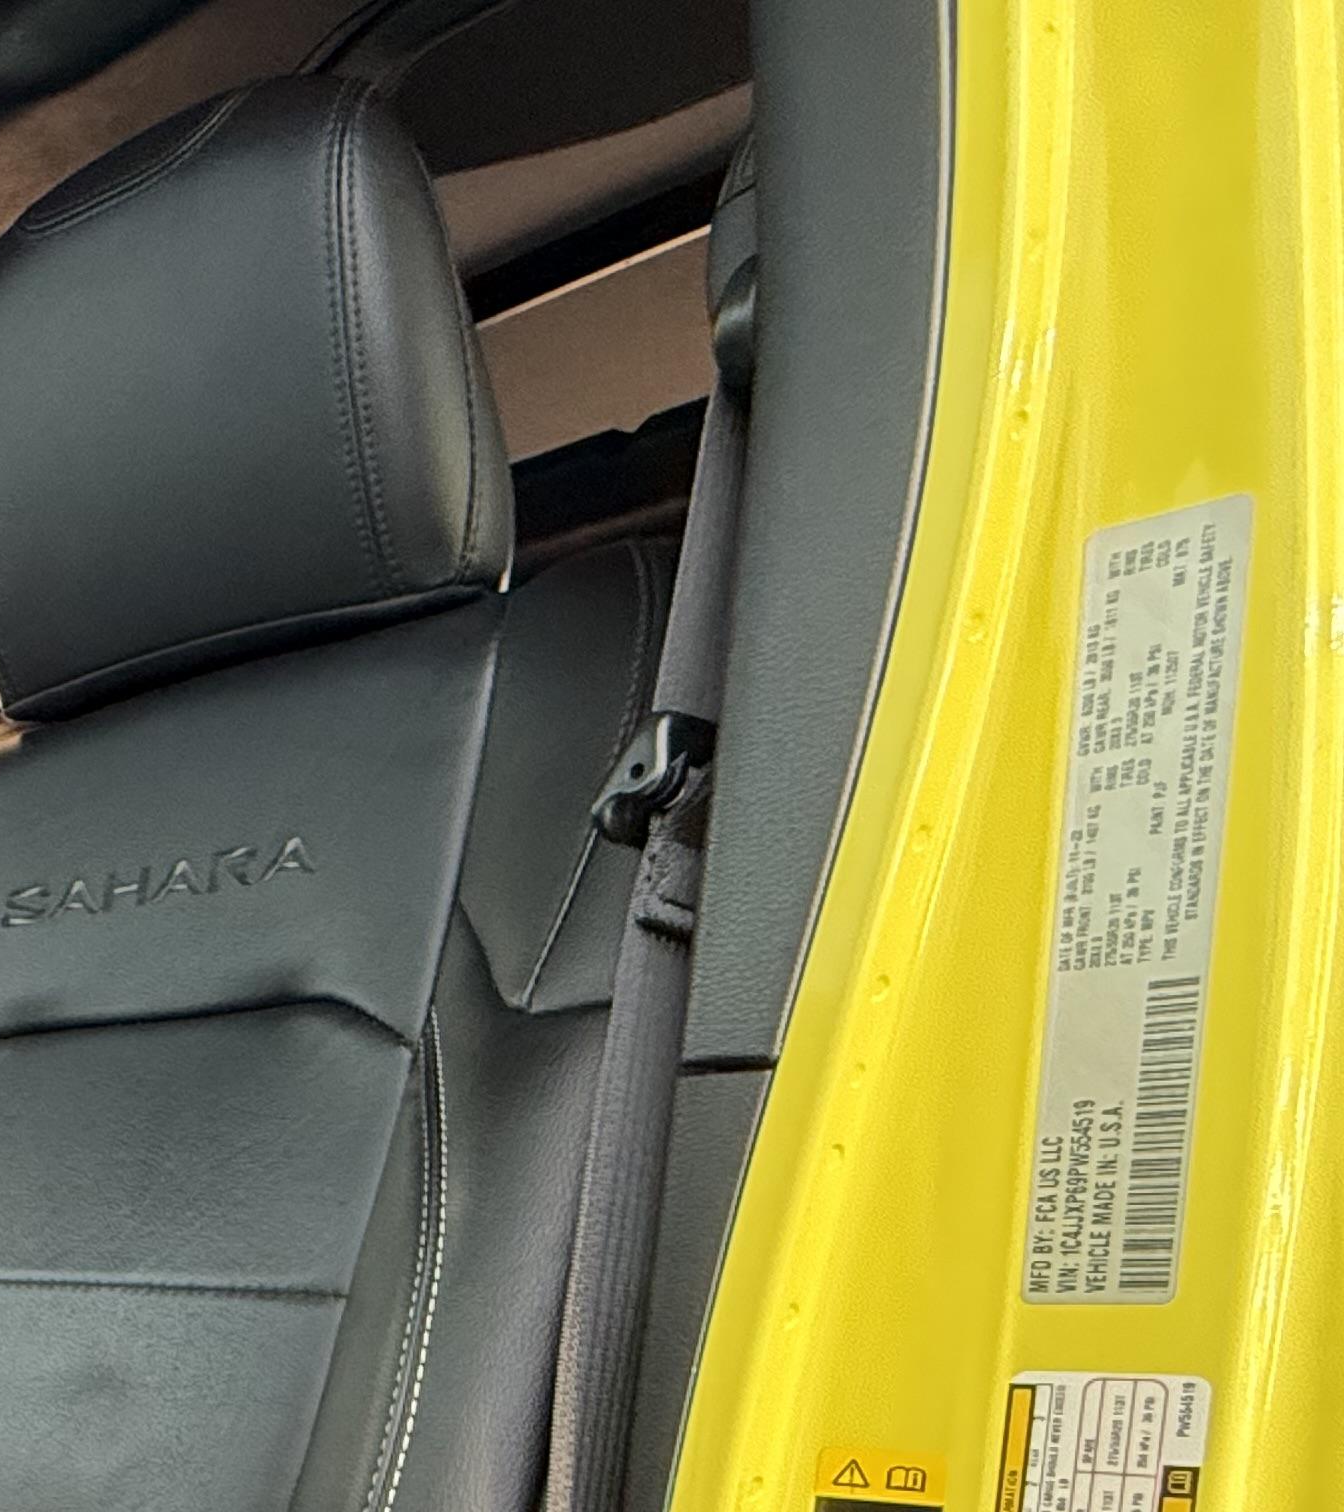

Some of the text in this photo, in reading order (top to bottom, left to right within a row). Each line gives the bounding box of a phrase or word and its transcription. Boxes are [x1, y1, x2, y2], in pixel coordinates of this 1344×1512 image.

[1, 837, 315, 927] SAHARA
[1028, 1136, 1063, 1293] MFD BY: FCA US LLC
[1055, 1098, 1094, 1293] VIN: 1C4JJXP69PW554519
[1084, 1099, 1123, 1294] VEHICLE MADE IN: U.S.A.
